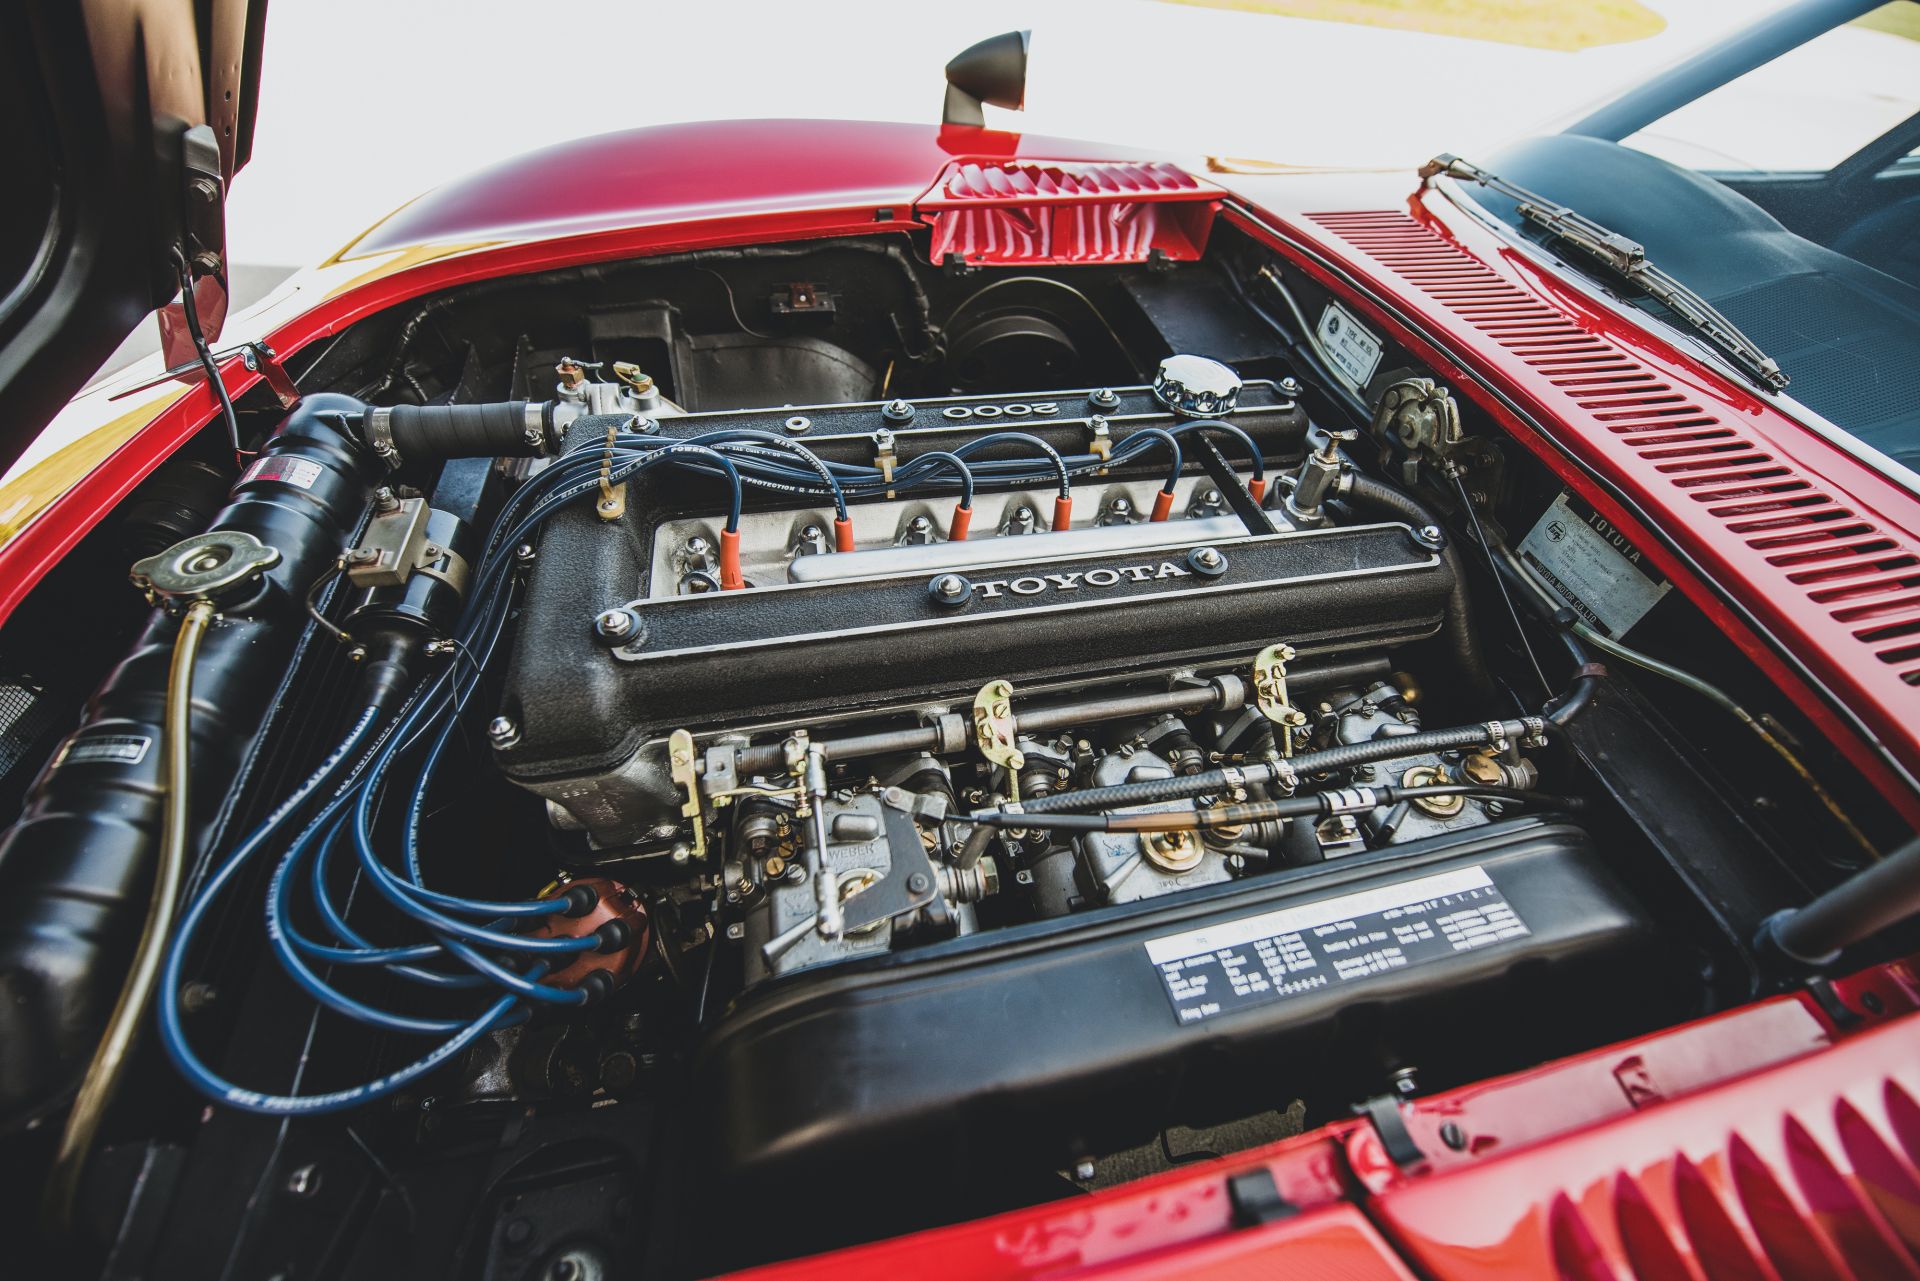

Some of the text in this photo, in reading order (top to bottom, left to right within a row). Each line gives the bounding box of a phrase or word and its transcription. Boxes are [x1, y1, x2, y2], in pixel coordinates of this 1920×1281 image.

[942, 402, 1060, 419] 2000
[646, 447, 667, 461] MAX
[670, 446, 707, 455] POWER
[774, 438, 832, 486] MAX PROTECTION
[746, 476, 797, 492] PROTECTION
[971, 562, 1192, 598] TOYOTA
[1555, 581, 1575, 602] MOTOR
[828, 842, 874, 860] WEBER
